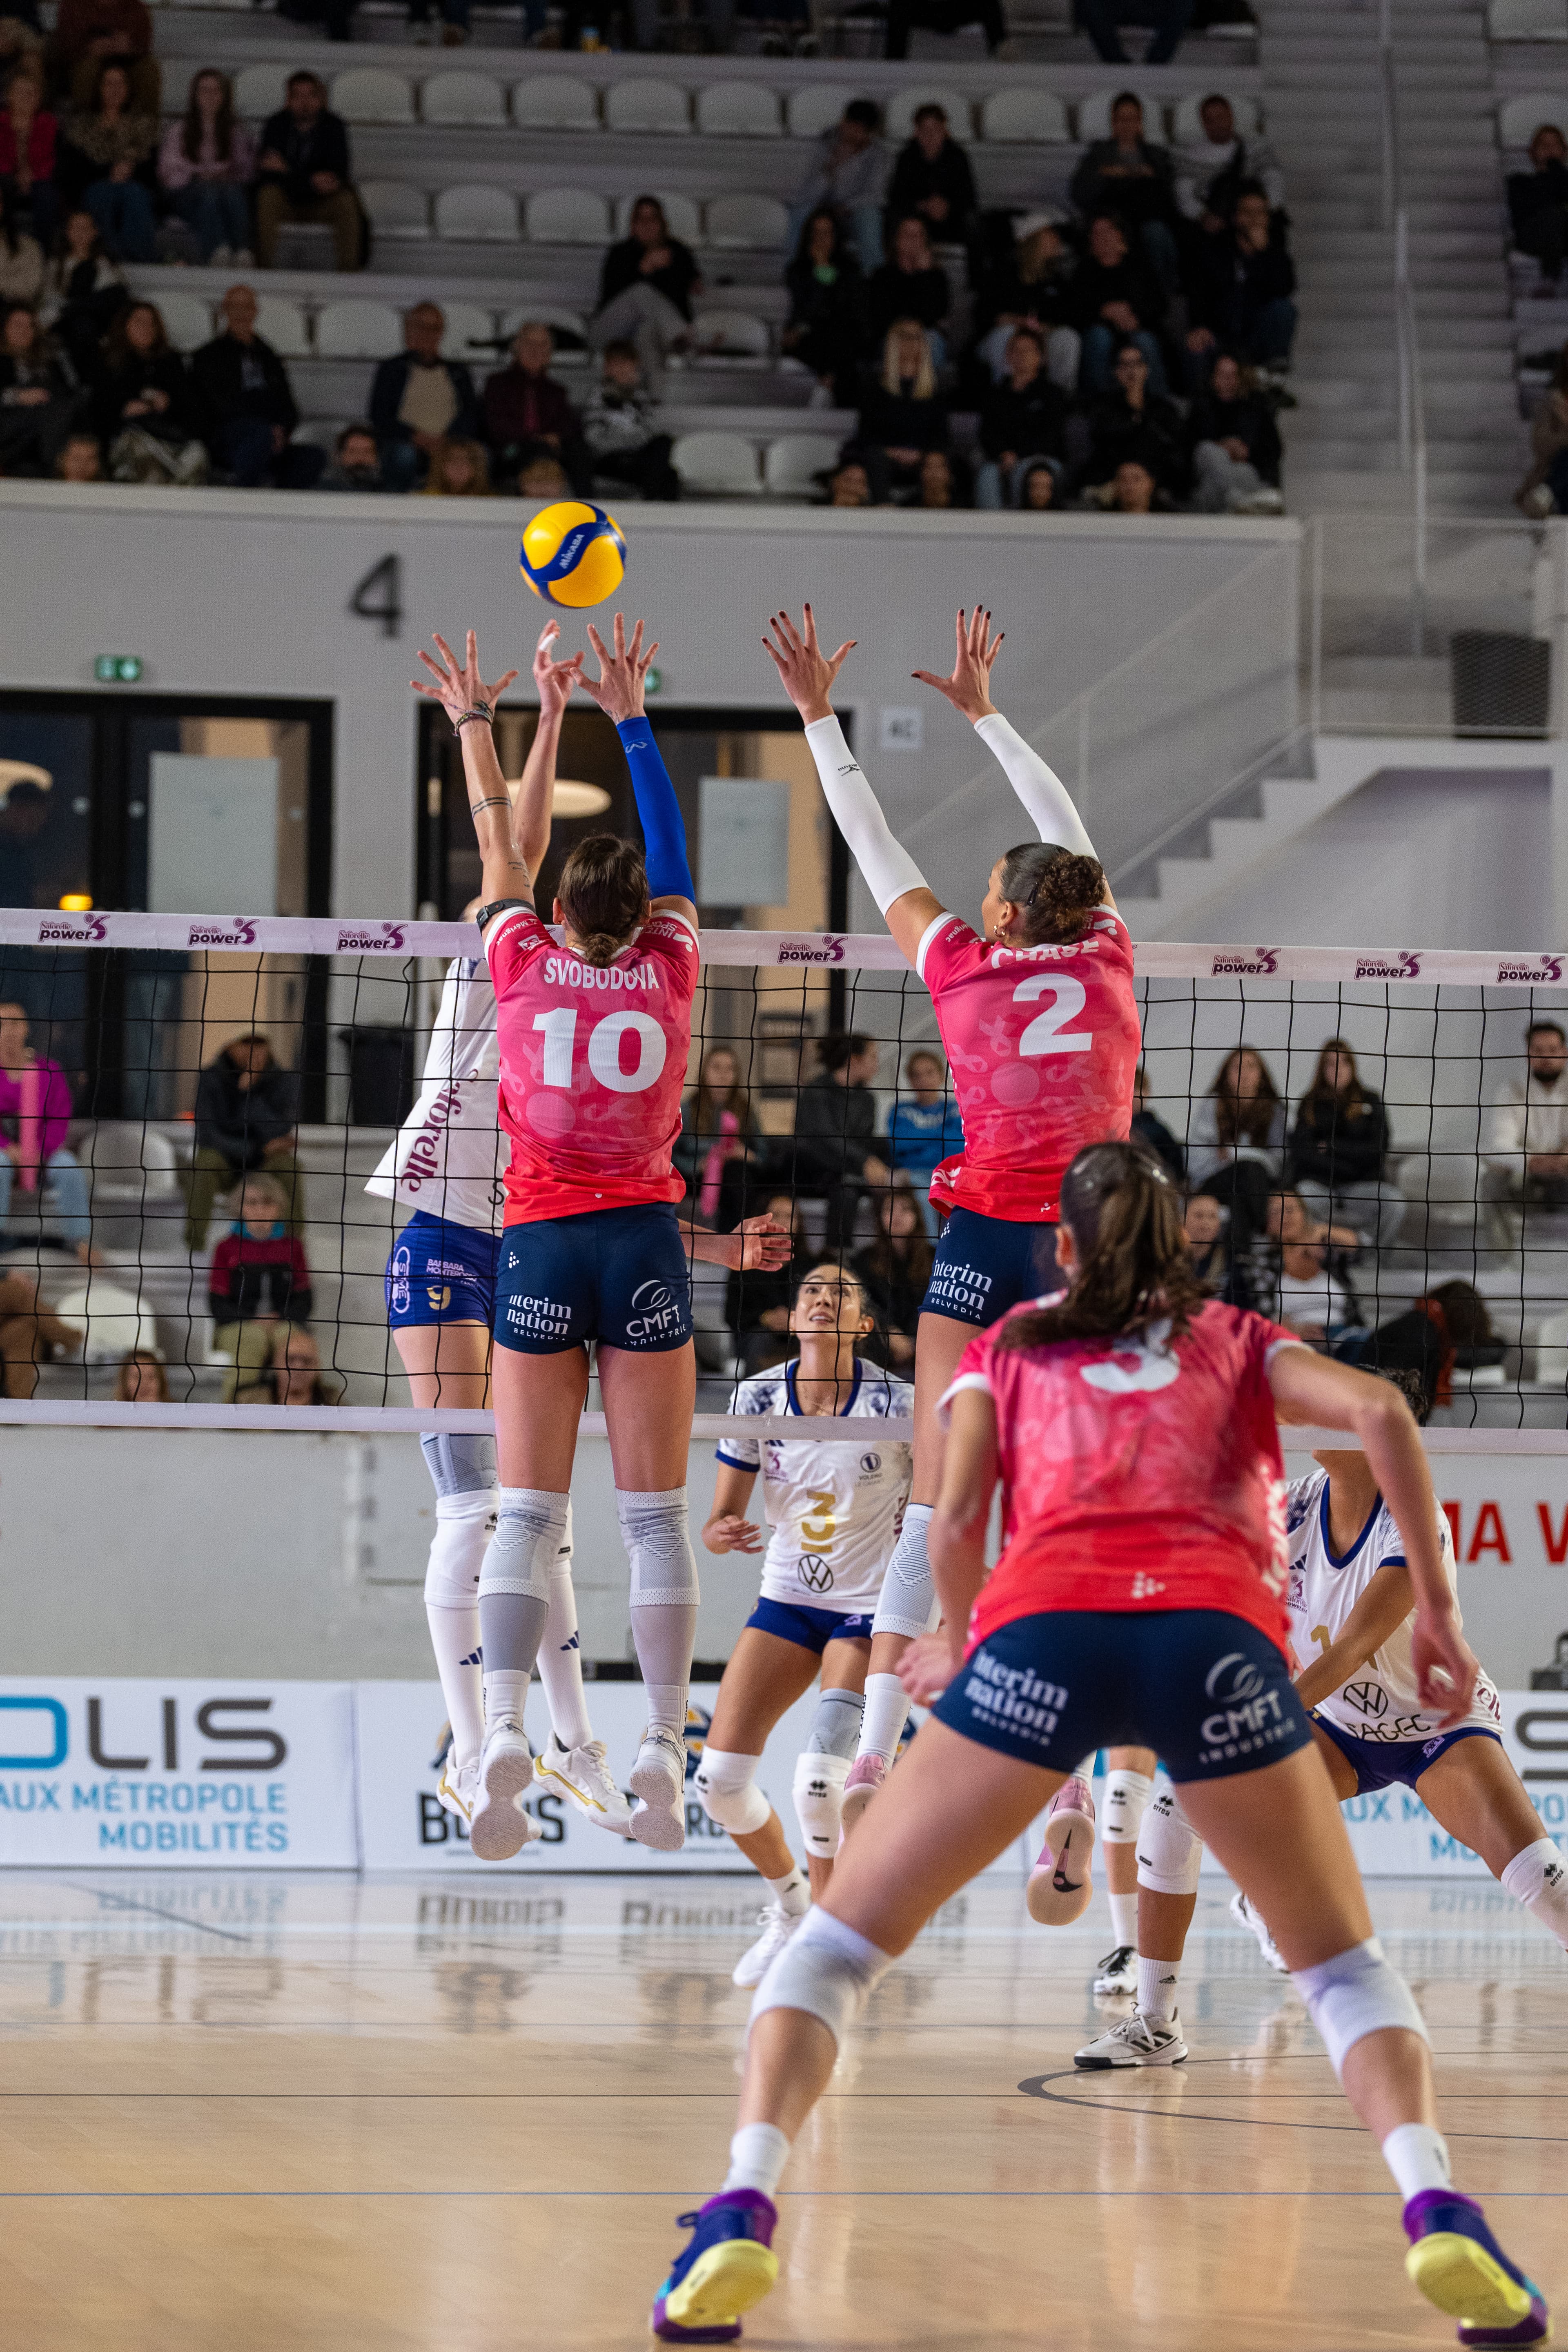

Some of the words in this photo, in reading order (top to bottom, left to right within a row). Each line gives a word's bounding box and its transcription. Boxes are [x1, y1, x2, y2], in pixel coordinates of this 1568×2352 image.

[350, 553, 402, 637] 4
[40, 929, 92, 941] power
[189, 934, 241, 945] power
[338, 939, 390, 950] power
[496, 920, 529, 946] Mérignac
[945, 924, 969, 942] érignac
[779, 951, 830, 962] power
[1500, 962, 1528, 971] Saforelle
[543, 957, 660, 990] SVOBODOVA
[1213, 964, 1263, 975] power
[1356, 967, 1405, 978] power
[1498, 971, 1548, 982] power
[1013, 973, 1092, 1056] 2
[532, 1007, 666, 1093] 10
[427, 1285, 451, 1310] 9
[929, 1279, 984, 1311] nation
[626, 1305, 679, 1336] CMFT
[931, 1297, 980, 1319] BELVEDIA
[506, 1309, 568, 1334] nation
[514, 1327, 565, 1341] BELVED
[802, 1490, 836, 1541] 3
[964, 1676, 1059, 1734] nation
[1200, 1689, 1282, 1744] CMFT
[72, 1776, 287, 1813] MÉTROPOLE
[1153, 1804, 1171, 1817] errea
[99, 1817, 289, 1852] MOBILITÉS
[1550, 1868, 1564, 1886] errea
